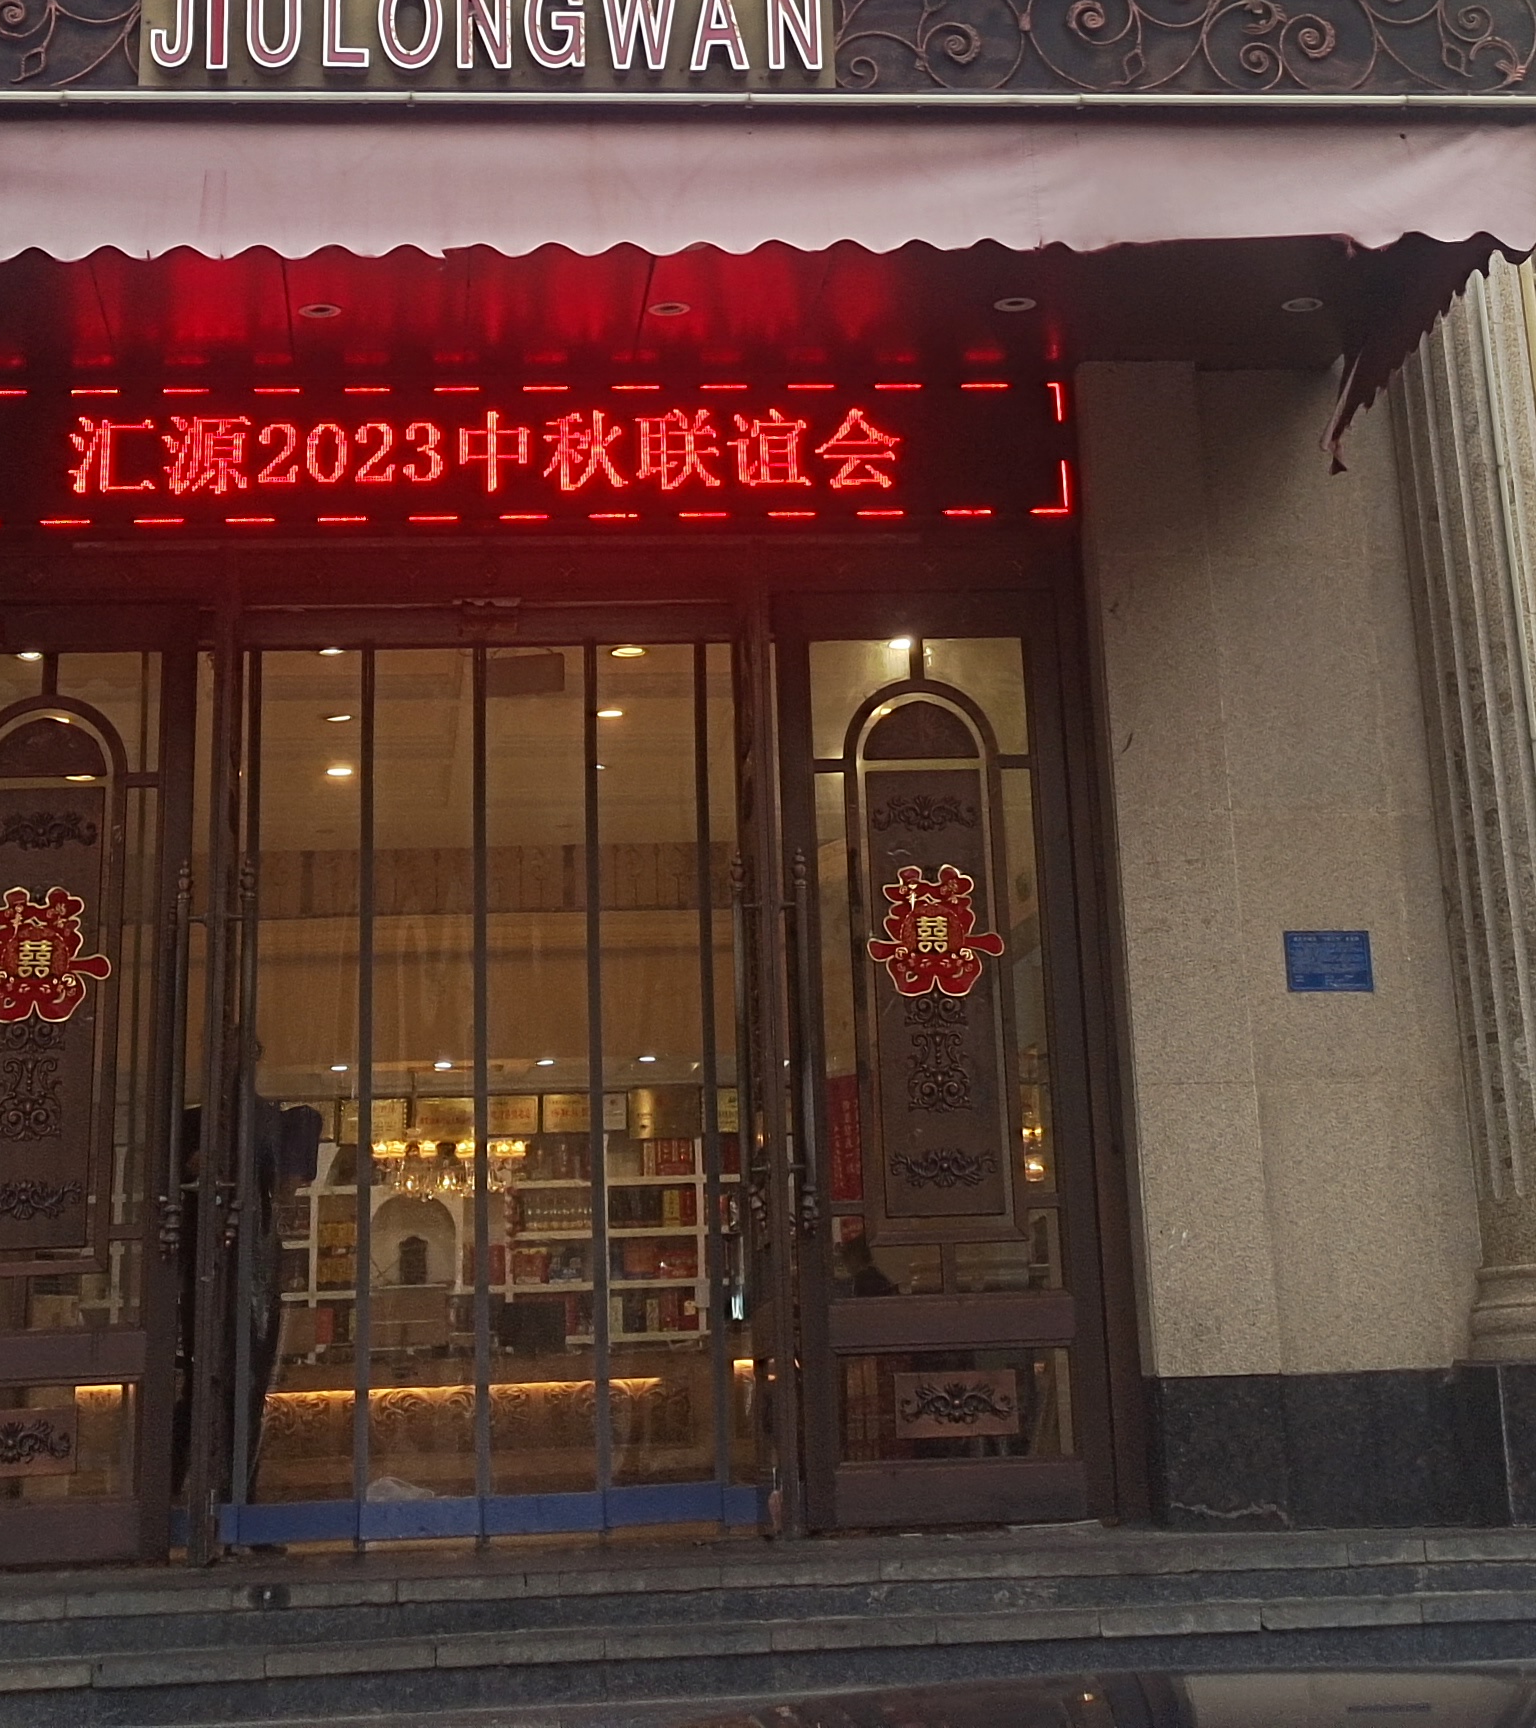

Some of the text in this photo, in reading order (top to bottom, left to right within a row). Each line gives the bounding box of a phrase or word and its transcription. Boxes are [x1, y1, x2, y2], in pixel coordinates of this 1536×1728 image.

[66, 406, 903, 496] 汇源2023中秋联谊会
